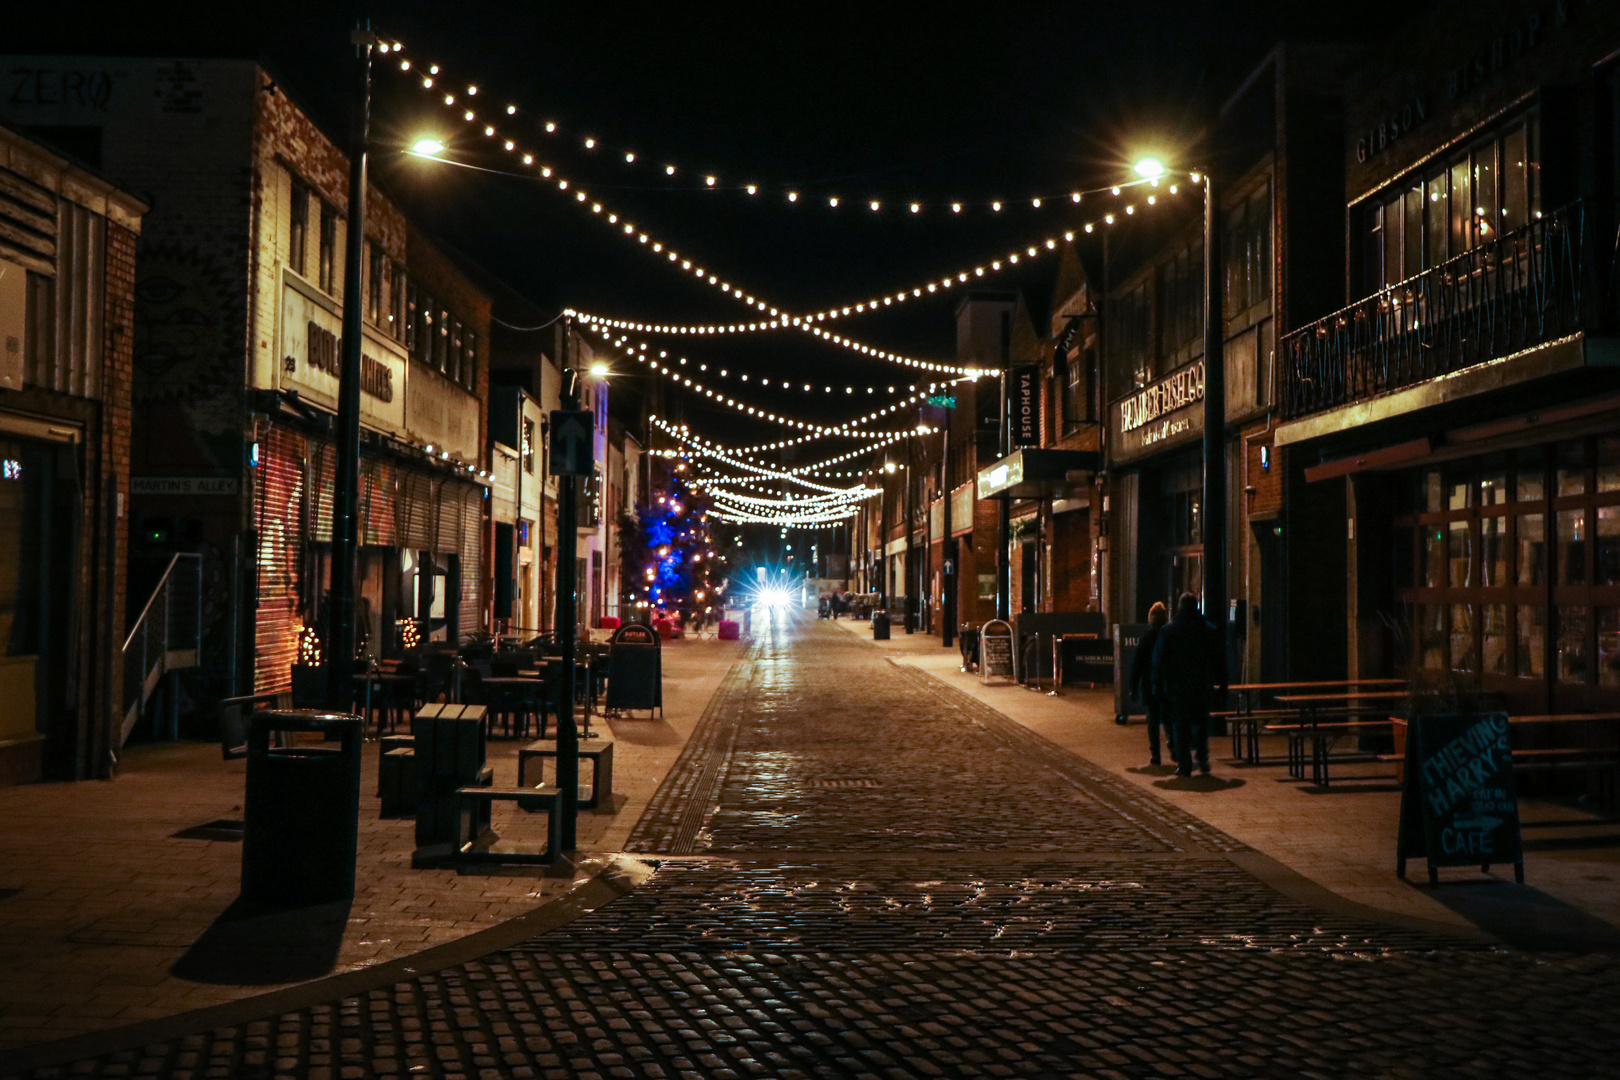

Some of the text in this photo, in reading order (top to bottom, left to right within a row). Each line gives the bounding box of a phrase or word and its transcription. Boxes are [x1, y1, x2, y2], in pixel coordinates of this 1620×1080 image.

[1356, 95, 1426, 164] GIBSON
[1020, 374, 1032, 438] TAPHOUSE
[1120, 385, 1161, 433] HUMBER
[1162, 372, 1186, 414] FISH
[133, 479, 234, 491] MARTIN'S ALLEY
[1422, 713, 1509, 788] THIEVING
[1427, 735, 1513, 817] HARRY'S
[1441, 827, 1494, 856] CAFE
